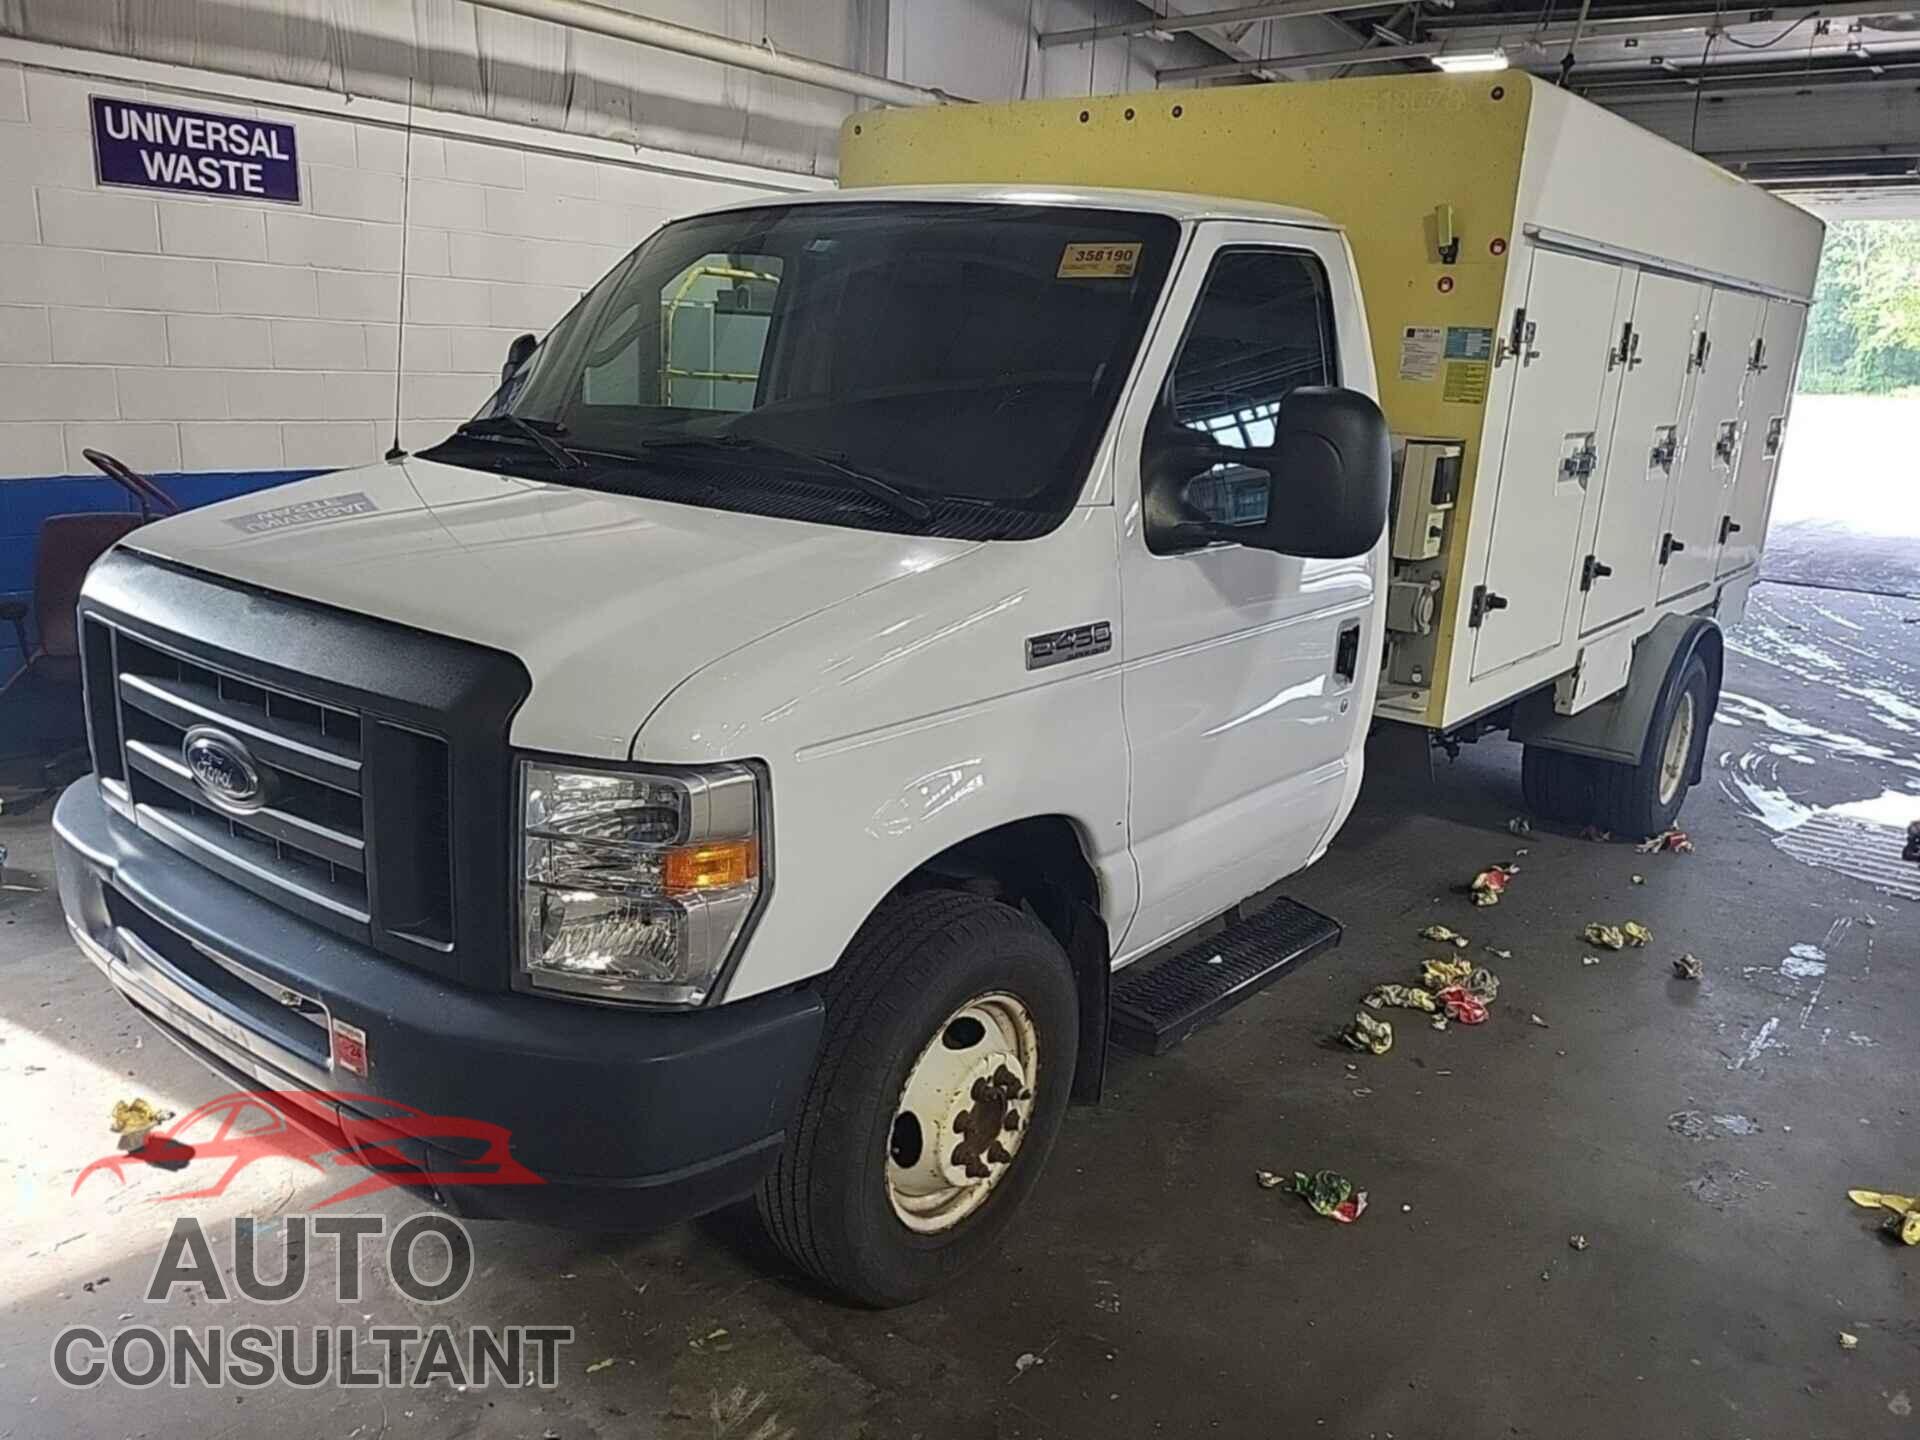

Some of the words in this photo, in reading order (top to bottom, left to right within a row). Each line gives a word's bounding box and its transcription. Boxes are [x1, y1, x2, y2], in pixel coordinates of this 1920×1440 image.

[104, 105, 290, 161] UNIVERSAL
[139, 149, 265, 194] WASTE
[197, 747, 233, 789] Ford
